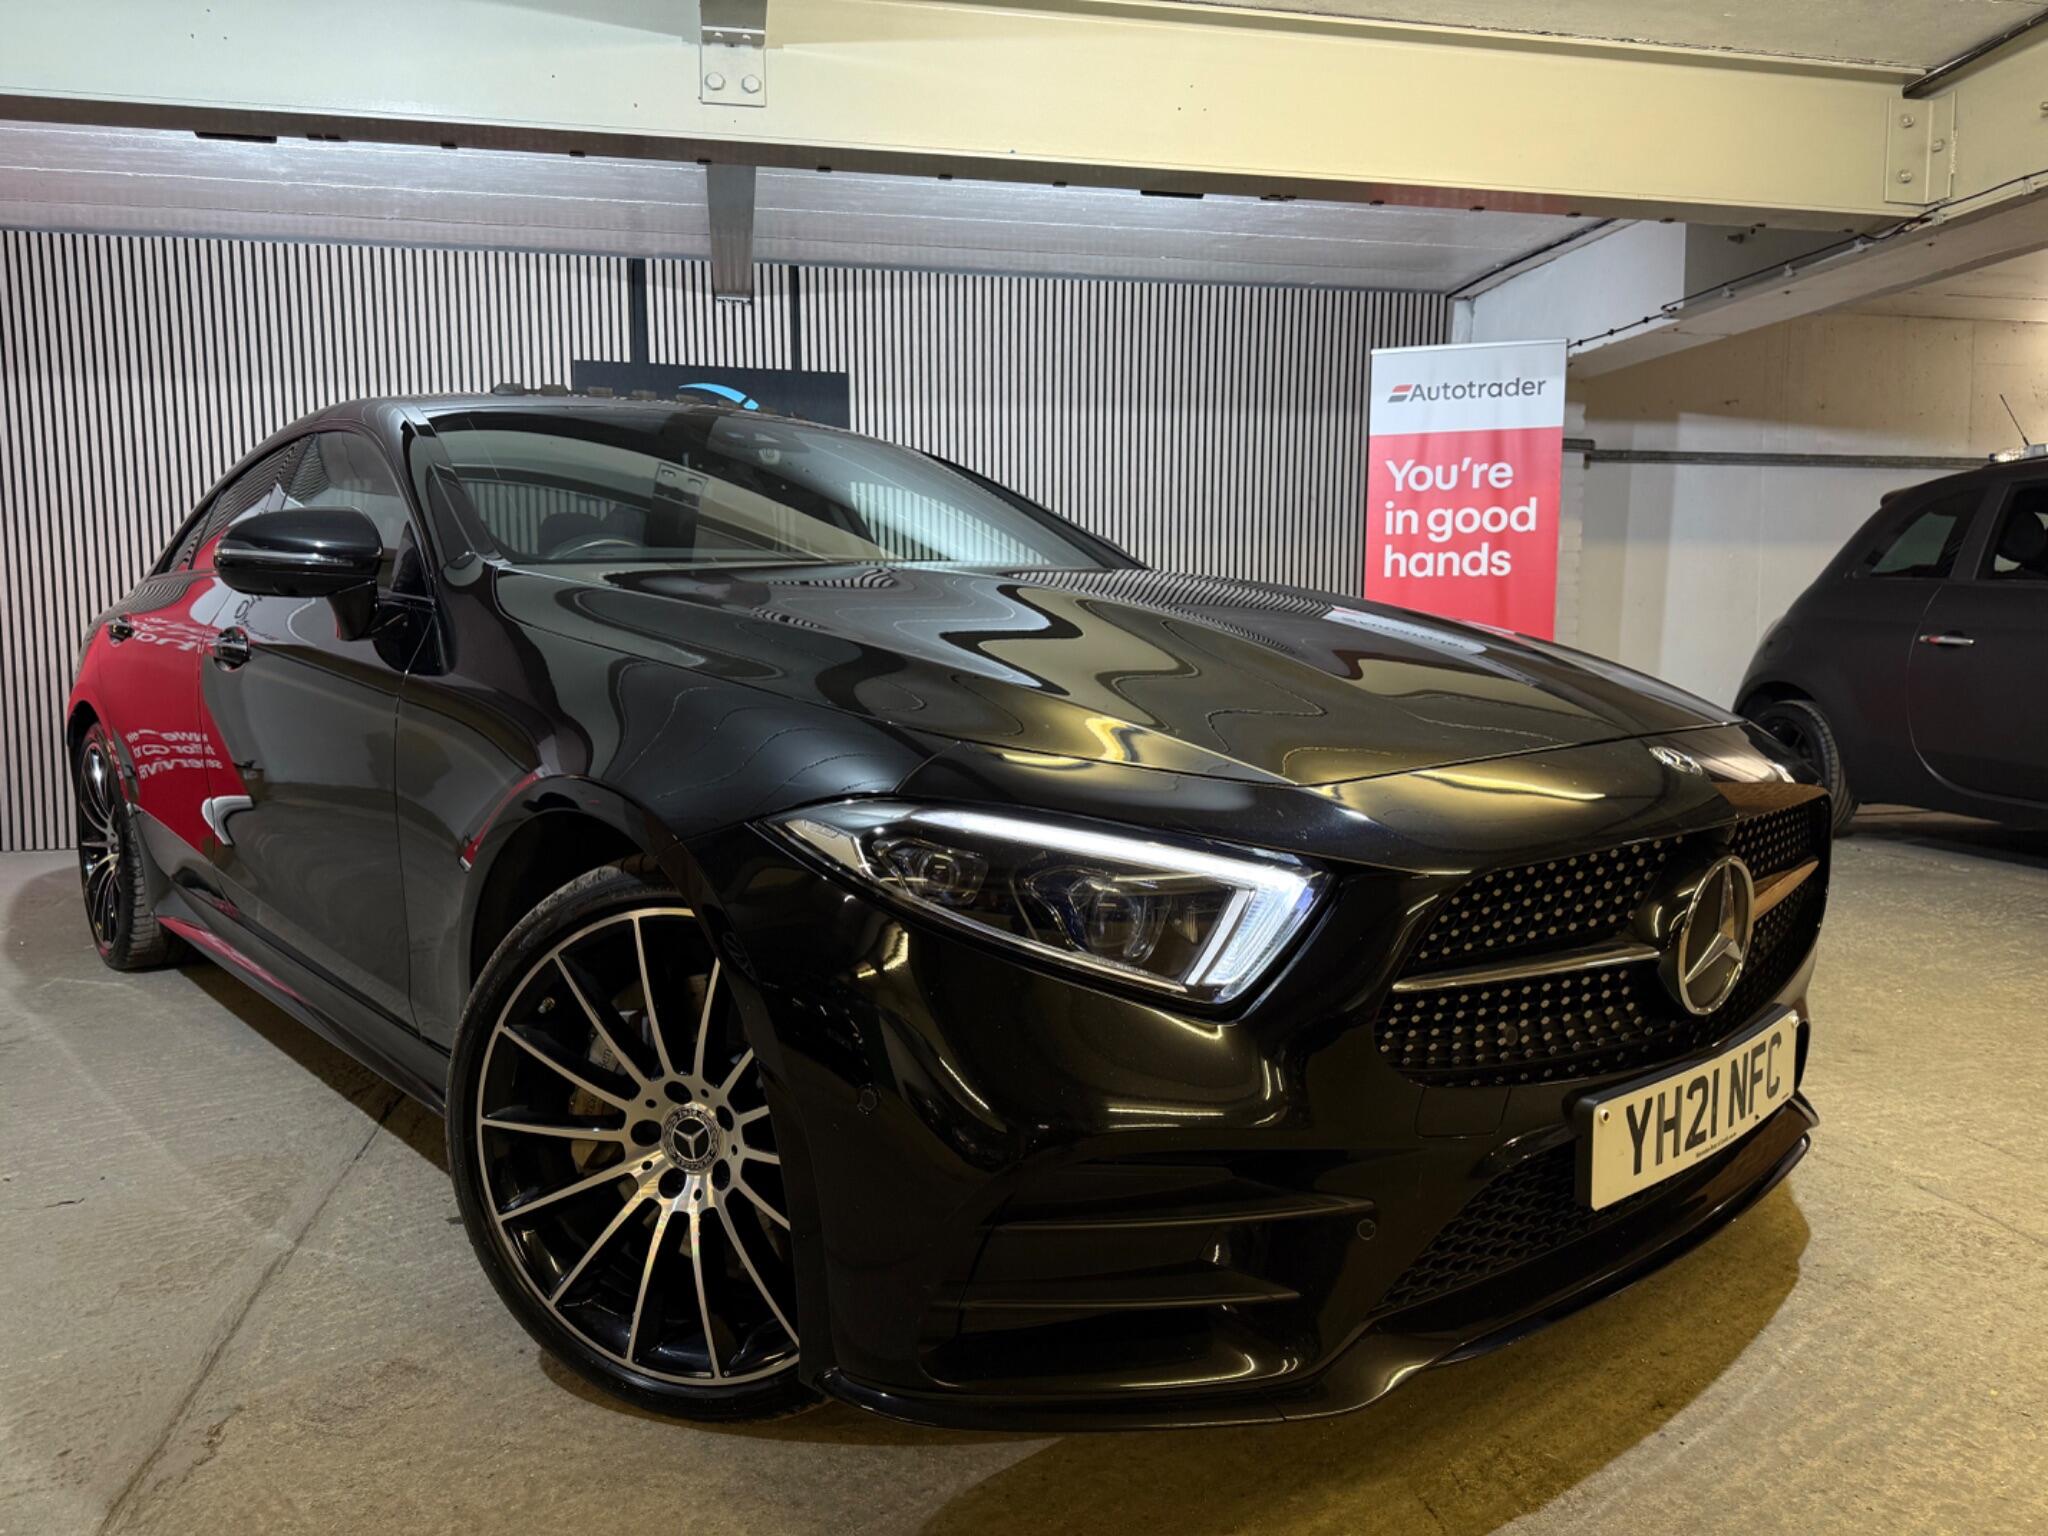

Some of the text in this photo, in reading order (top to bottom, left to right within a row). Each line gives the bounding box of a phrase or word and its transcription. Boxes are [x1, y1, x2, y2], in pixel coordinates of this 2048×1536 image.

[1409, 377, 1546, 402] Autotrader
[1386, 457, 1513, 491] You’re
[1385, 497, 1536, 542] in good
[1383, 543, 1511, 577] hands
[1626, 1032, 1782, 1175] YH21 NFC
